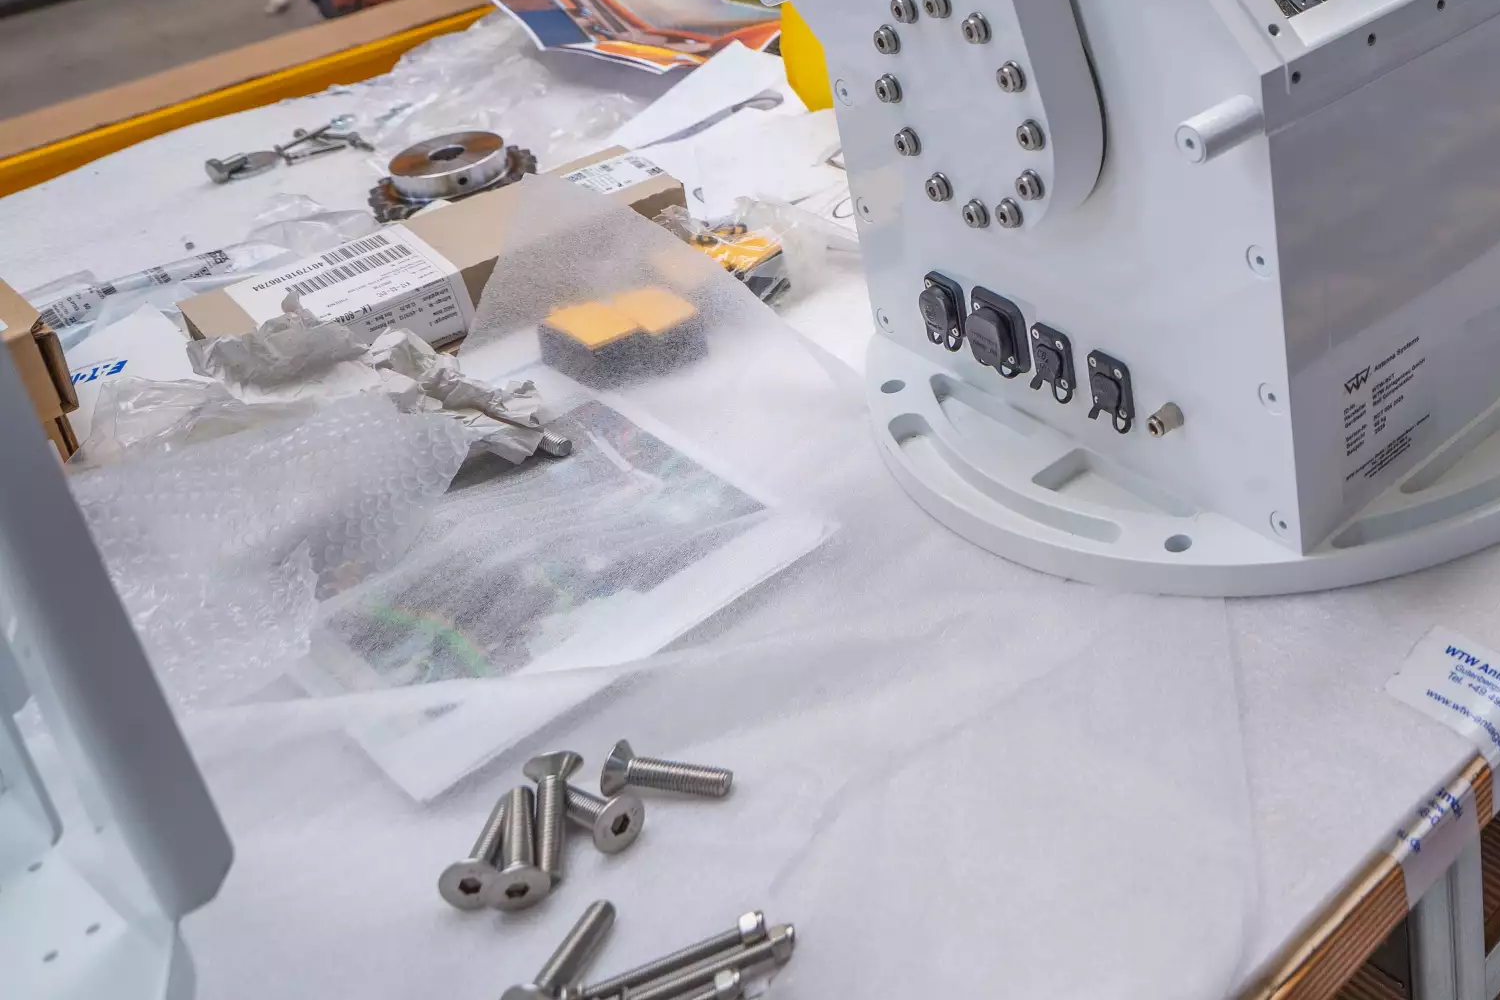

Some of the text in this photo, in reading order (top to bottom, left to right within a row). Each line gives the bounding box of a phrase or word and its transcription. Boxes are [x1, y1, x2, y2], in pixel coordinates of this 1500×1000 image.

[1344, 336, 1420, 395] WTW Antenna Systems
[1445, 645, 1480, 666] WTW
